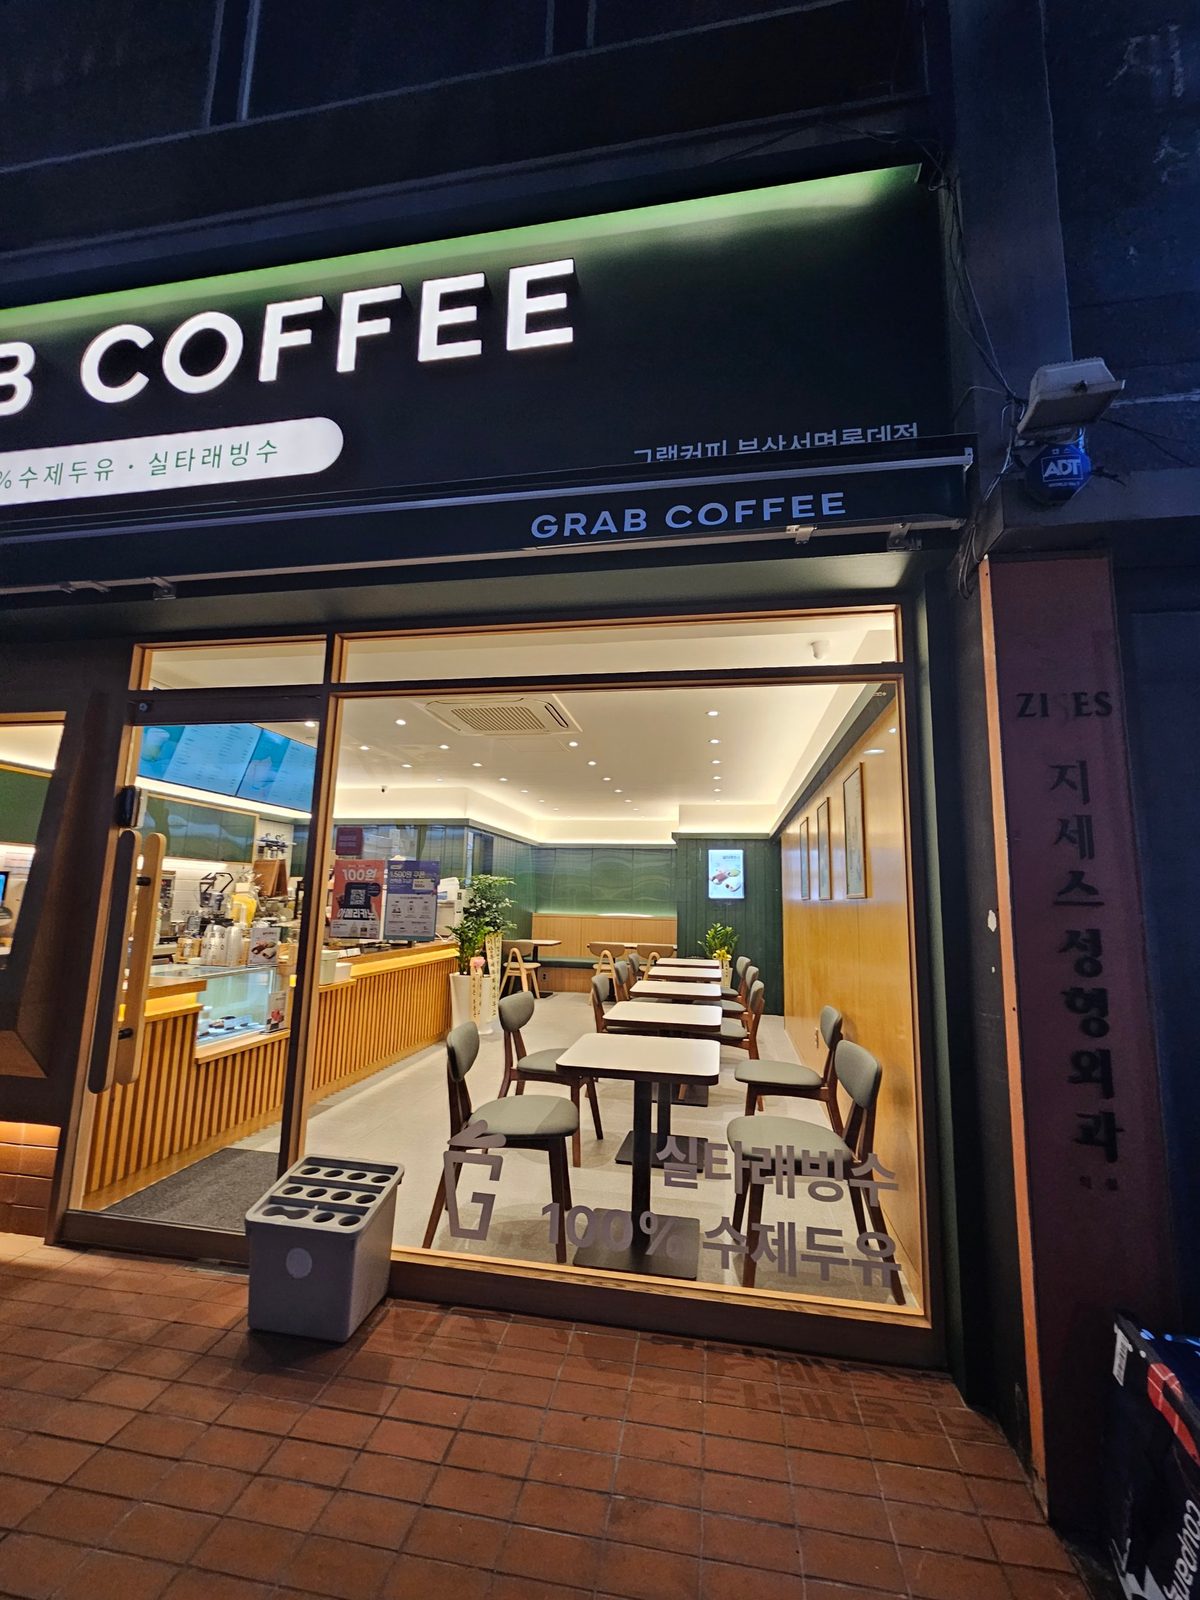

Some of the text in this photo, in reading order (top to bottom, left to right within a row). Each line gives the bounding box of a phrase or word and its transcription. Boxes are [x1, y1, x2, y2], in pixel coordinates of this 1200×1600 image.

[80, 258, 575, 404] COFFEE
[148, 439, 279, 477] 실타래빙수
[1044, 459, 1081, 477] ADT
[530, 492, 847, 539] GRAB COFFEE
[656, 1135, 900, 1208] 실타래빙수
[541, 1201, 902, 1288] 100% 수제두유
